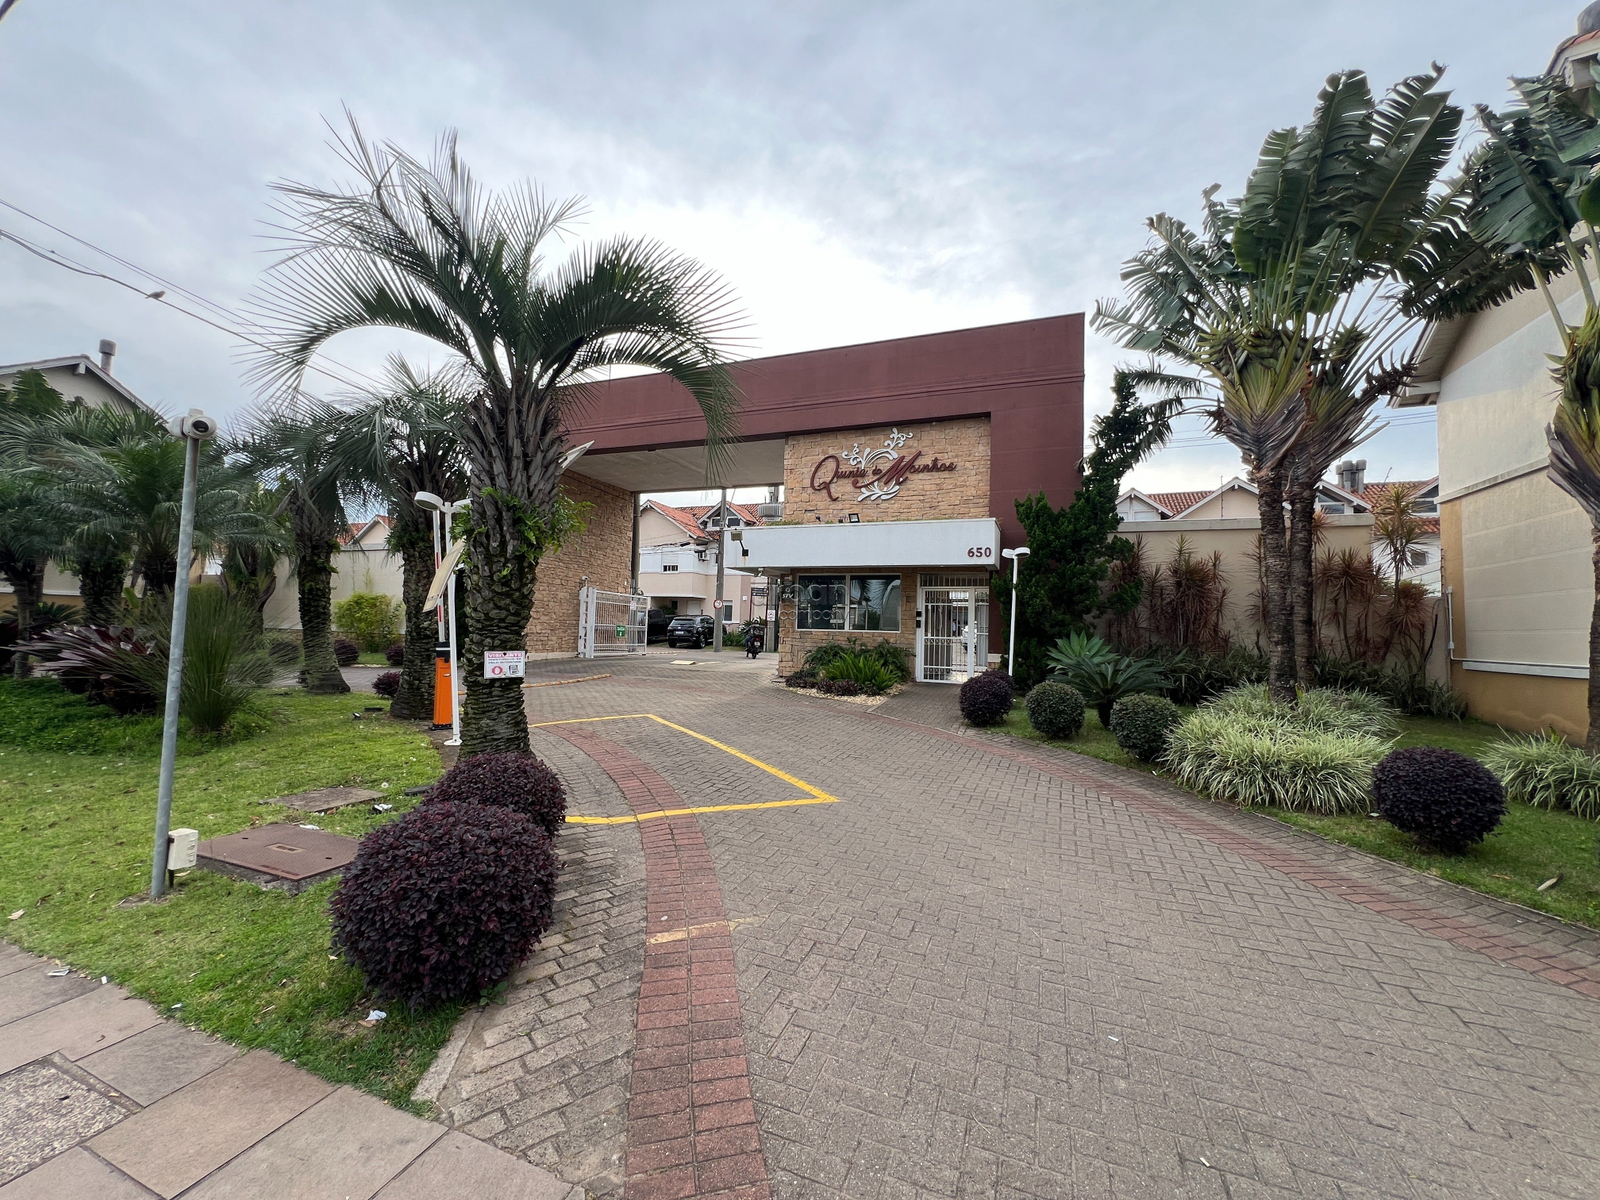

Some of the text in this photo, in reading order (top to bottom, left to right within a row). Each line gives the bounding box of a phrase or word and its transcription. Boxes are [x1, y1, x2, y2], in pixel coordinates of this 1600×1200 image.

[810, 454, 869, 501] Quinta
[852, 450, 958, 489] Moinhos
[967, 547, 992, 558] 650
